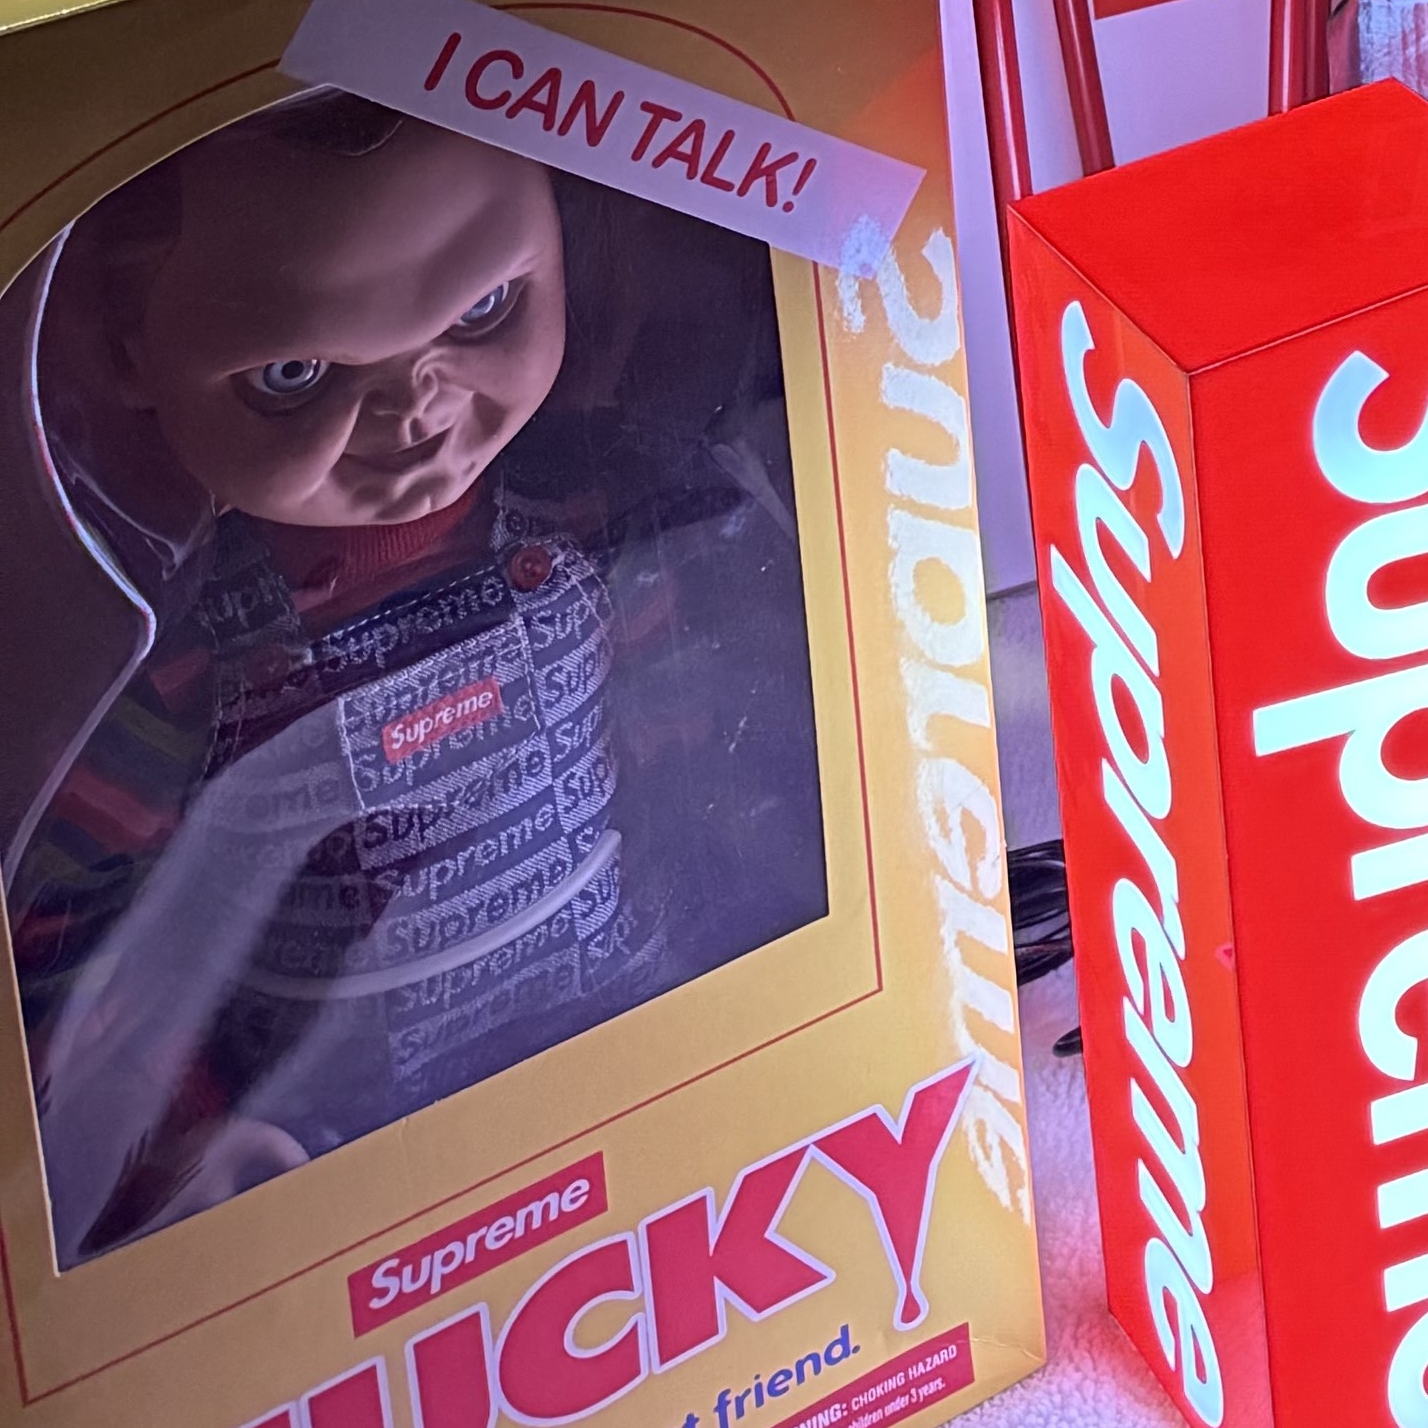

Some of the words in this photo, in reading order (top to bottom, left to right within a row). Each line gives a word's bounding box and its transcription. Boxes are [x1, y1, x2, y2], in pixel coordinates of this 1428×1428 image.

[423, 32, 461, 92] I
[465, 48, 625, 149] CAN
[629, 101, 817, 216] TALK!
[391, 691, 493, 749] Supreme
[1050, 299, 1226, 1428] Supreme
[368, 1177, 590, 1310] Supreme
[713, 1323, 861, 1428] friend.
[851, 1372, 906, 1412] CHOKING
[908, 1344, 957, 1381] HAZARD
